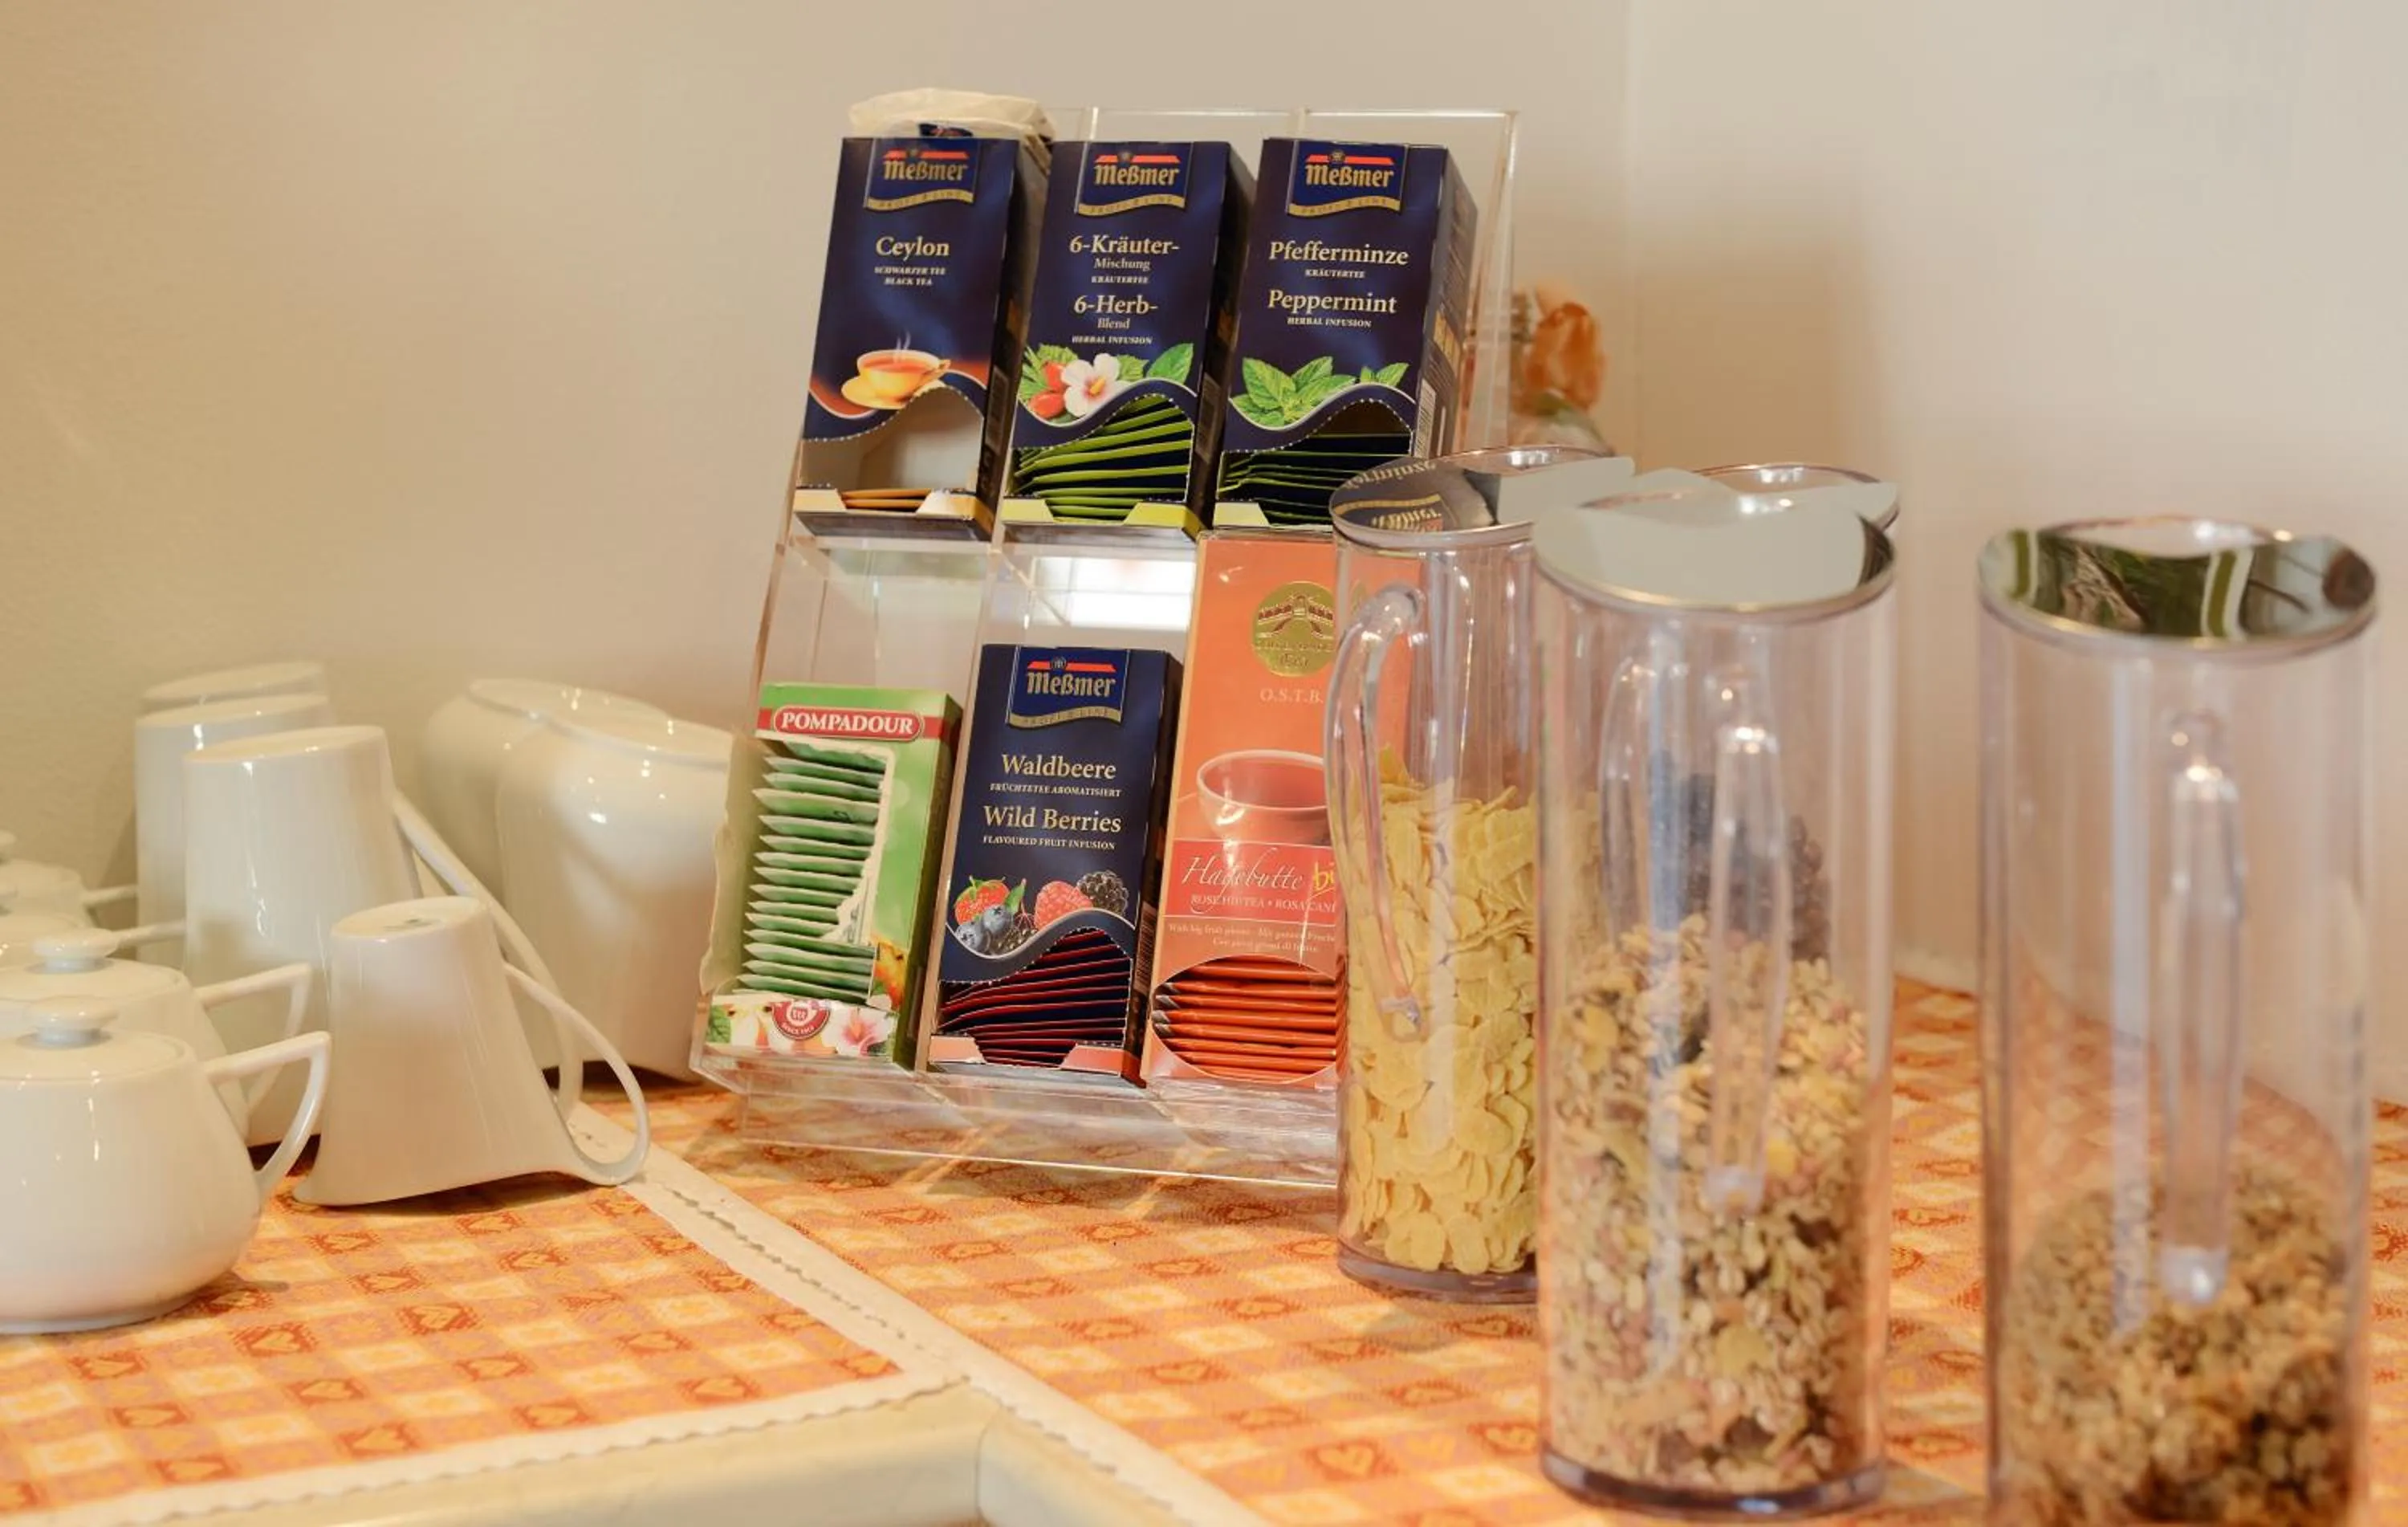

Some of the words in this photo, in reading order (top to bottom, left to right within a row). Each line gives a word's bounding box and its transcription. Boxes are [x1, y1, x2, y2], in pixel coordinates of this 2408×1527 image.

[883, 161, 968, 181] Meßmer
[1093, 165, 1181, 186] Meßmer
[1304, 164, 1394, 187] Meßmer
[876, 237, 950, 261] Ceylon
[1069, 234, 1180, 254] 6-Kräuter-
[1268, 241, 1409, 265] Pfefferminze
[1093, 258, 1151, 271] Mischung
[1305, 268, 1365, 279] KRÄUTERTEE
[1073, 294, 1158, 315] 6-Herb-
[1267, 289, 1397, 315] Peppermint
[1096, 317, 1131, 329] Blend
[1287, 316, 1324, 326] HERBAL
[1325, 318, 1373, 328] INFUSION
[1026, 671, 1117, 697] Meßmer
[781, 712, 913, 734] POMPADOUR
[1001, 753, 1117, 780] Waldbeere
[1051, 786, 1122, 797] AROMATISIERT
[982, 804, 1036, 828] Wild
[1043, 808, 1122, 833] Berries
[982, 835, 1037, 845] FLAVOURED
[1039, 837, 1067, 847] FRUIT
[1068, 840, 1116, 850] INFUSION
[1314, 861, 1335, 891] bi
